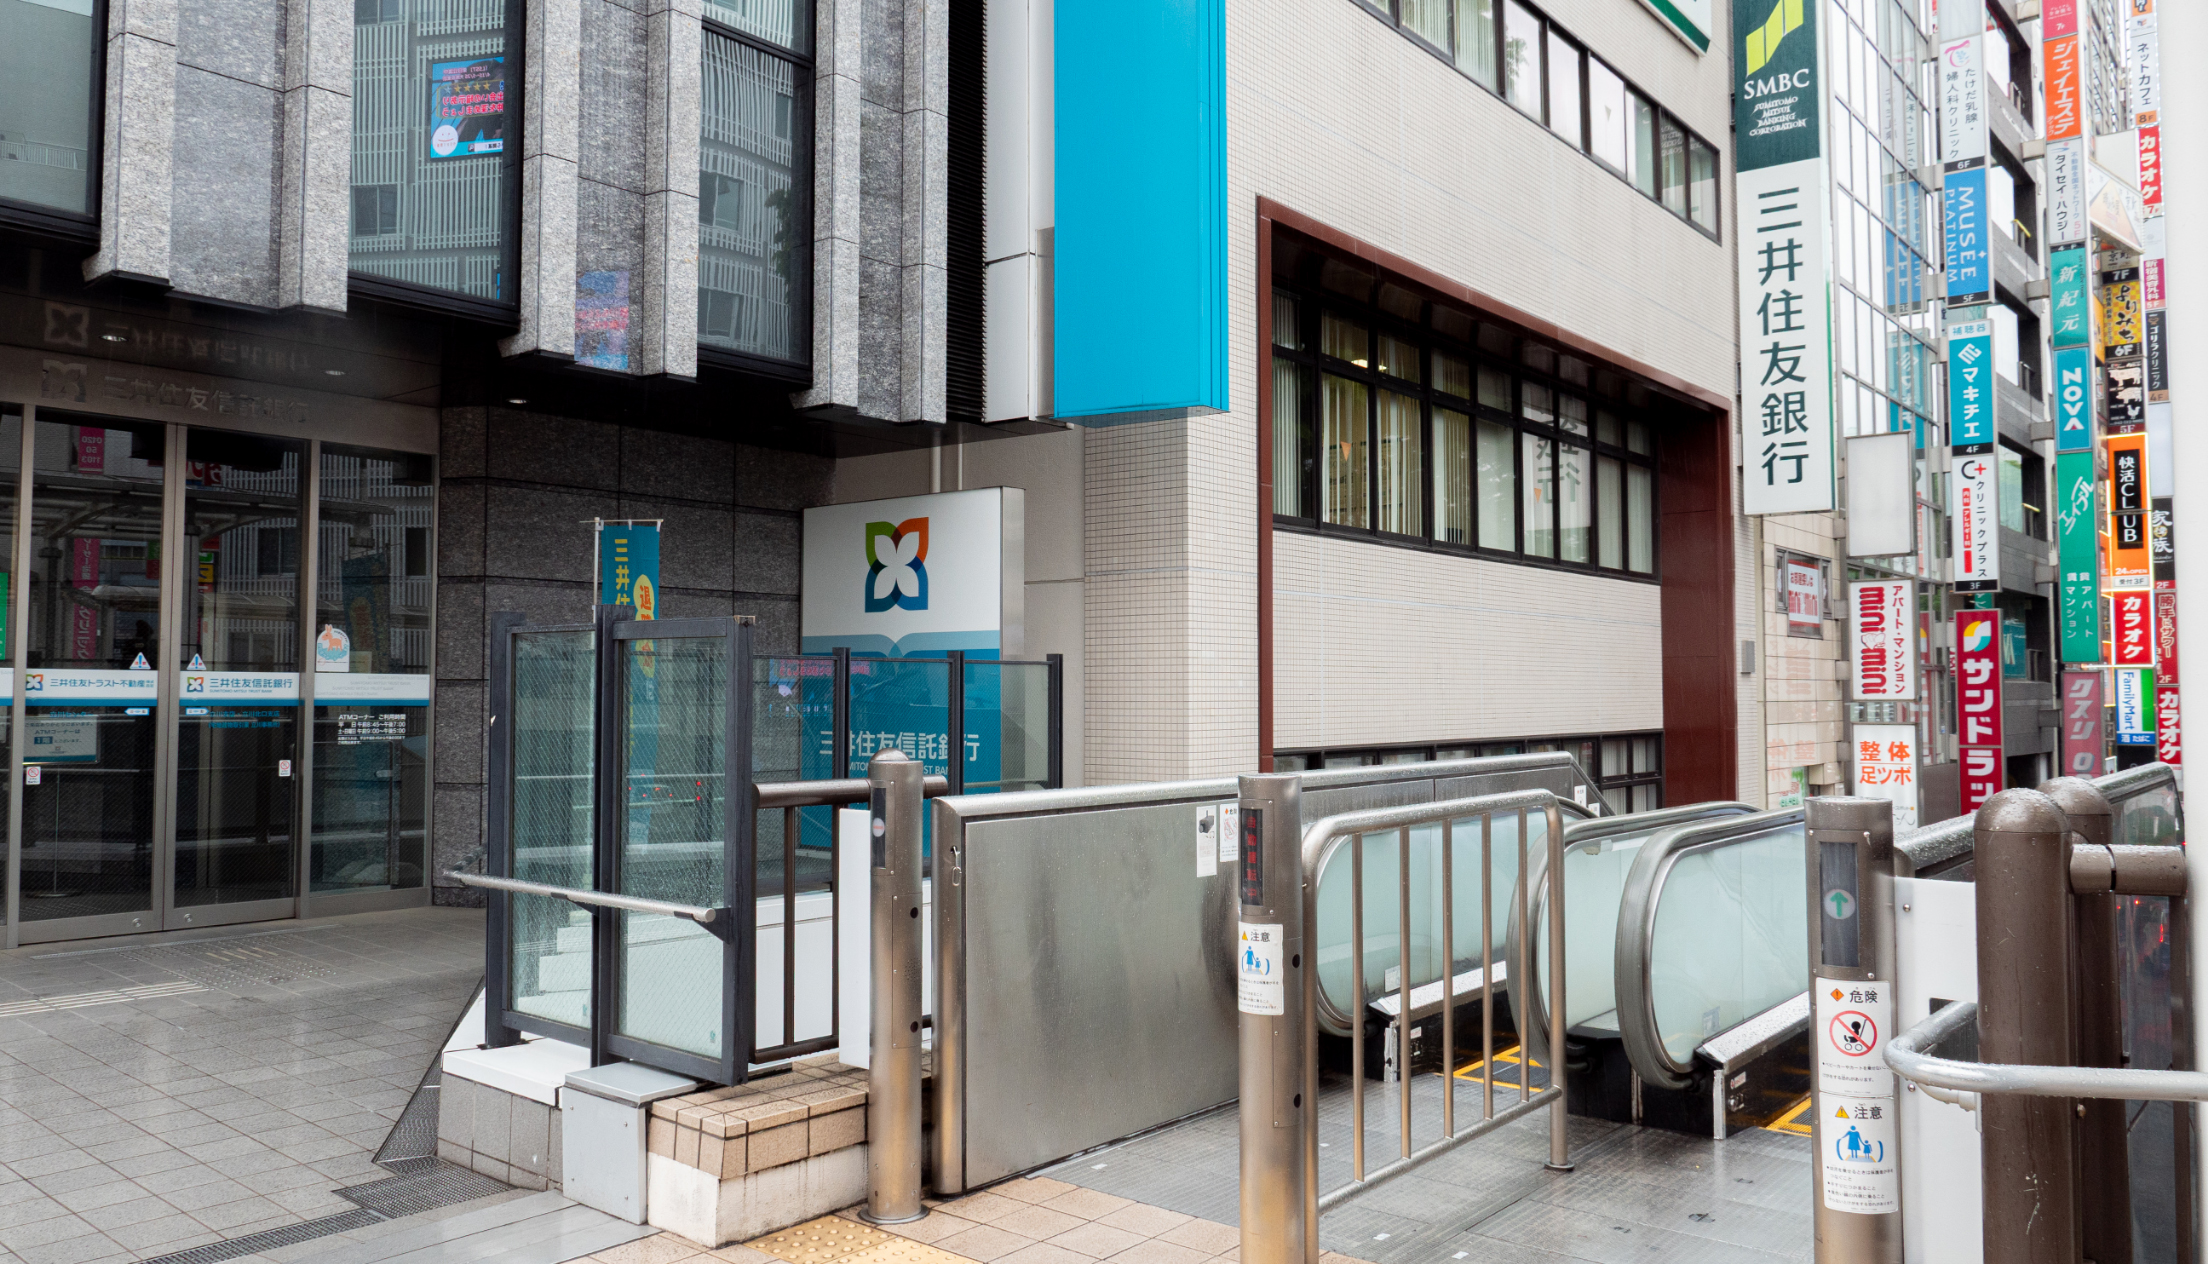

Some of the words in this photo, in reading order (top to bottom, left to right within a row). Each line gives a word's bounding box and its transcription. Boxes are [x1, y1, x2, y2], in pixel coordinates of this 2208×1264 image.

[1744, 68, 1810, 100] SMBC
[2052, 41, 2077, 135] ジェイエステ
[2137, 43, 2151, 105] ネットカフェ
[1753, 96, 1798, 113] SUMITOMO
[1756, 112, 1796, 128] BANKING
[1762, 105, 1791, 118] MITSUI
[1946, 71, 1959, 159] 婦人科クリニック
[1749, 118, 1806, 136] CORPORATION
[1957, 161, 1971, 169] 6F
[2140, 135, 2161, 200] カラオケ
[2055, 155, 2068, 240] タイセイ・ハウジー
[1945, 189, 1958, 282] PLATINUM
[1959, 187, 1977, 280] MUSEE
[2112, 269, 2129, 281] 7F
[2145, 261, 2159, 300] 新宿美容外科
[1963, 294, 1975, 303] 5F
[2055, 265, 2079, 334] 新紀元
[2115, 285, 2137, 340] よりみち
[1756, 186, 1809, 486] 三井住友銀行
[1953, 323, 1986, 335] 補聴器
[2115, 344, 2134, 356] 6F
[2149, 326, 2161, 389] ゴリラクリニック
[1962, 367, 1980, 437] マキチエ
[2062, 367, 2085, 431] NOVA
[1966, 445, 1979, 453] 4F
[2119, 456, 2138, 542] 快活CLUB
[1976, 481, 1987, 577] クリニックプラス
[1970, 582, 1981, 590] 3F
[2156, 581, 2169, 590] 2F
[1892, 585, 1905, 694] アパート・マンション
[2122, 596, 2144, 659] カラオケ
[2158, 594, 2175, 658] 勝手にサワー
[50, 678, 145, 688] 三井住友トラスト不動産
[210, 678, 293, 688] 三井住友信託銀行
[2159, 675, 2172, 684] 2F
[2068, 679, 2095, 740] クスリ
[2122, 672, 2136, 730] FamilyMart
[2159, 691, 2180, 760] カラオケ
[1860, 741, 1910, 762] 整体
[1860, 766, 1912, 786] 足ツボ
[1250, 931, 1270, 942] 注意
[1849, 990, 1878, 1004] 危険
[1854, 1106, 1882, 1119] 注意
